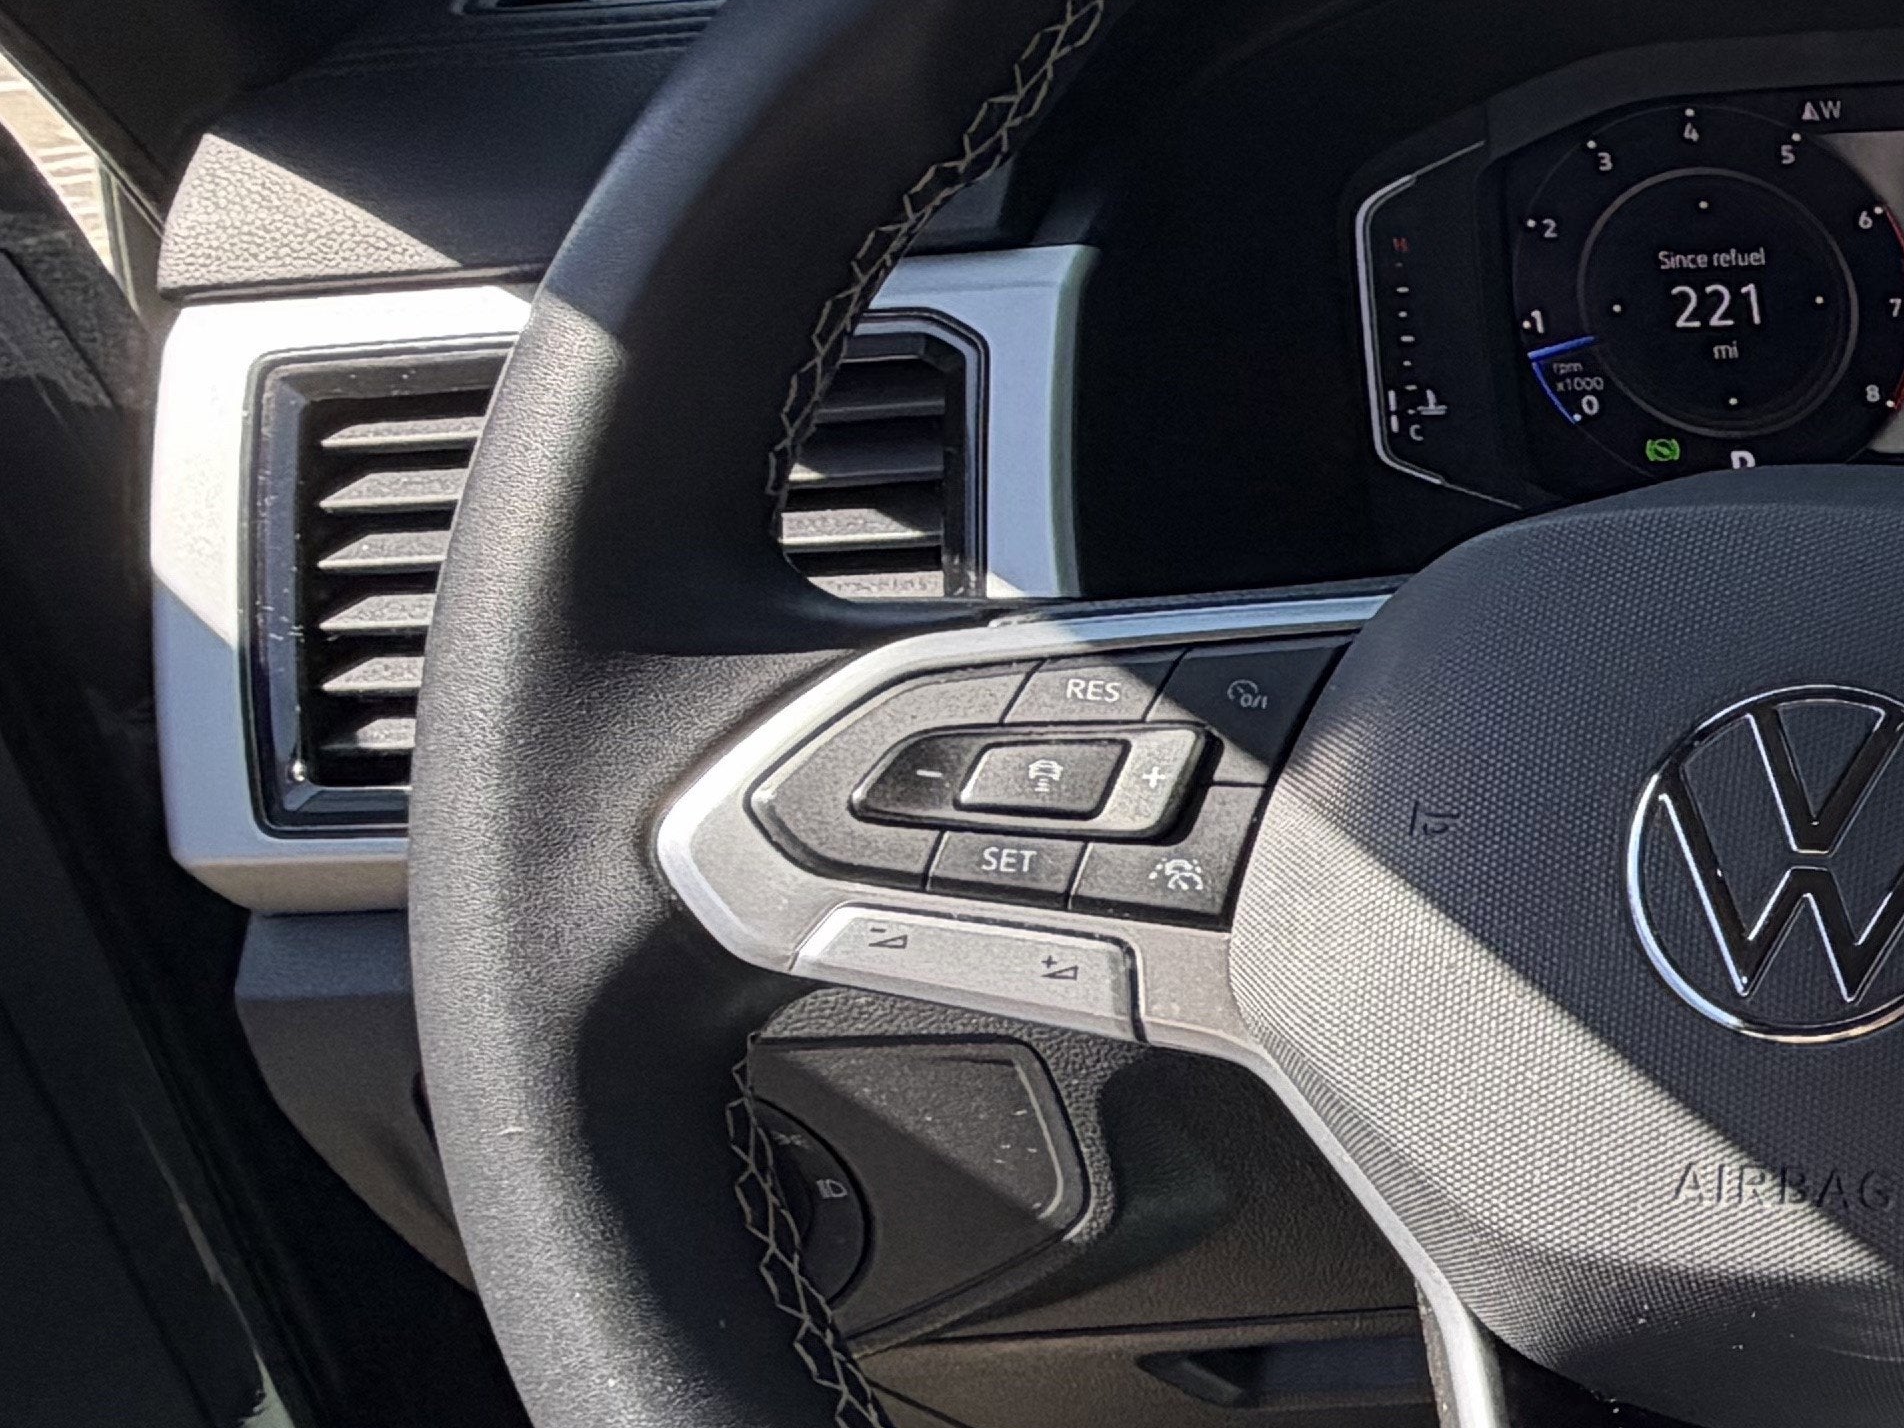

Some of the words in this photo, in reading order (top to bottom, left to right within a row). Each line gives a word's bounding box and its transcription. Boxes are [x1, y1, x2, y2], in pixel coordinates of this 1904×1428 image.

[1683, 122, 1700, 143] 4
[1597, 150, 1613, 172] 3
[1781, 143, 1795, 164] 5
[1543, 219, 1558, 239] 2
[1858, 210, 1873, 230] 6
[1658, 249, 1709, 271] Since
[1713, 246, 1767, 269] refuel
[1671, 283, 1763, 329] 221
[1889, 299, 1901, 318] 7
[1530, 308, 1545, 334] 1
[1712, 339, 1740, 360] mi
[1865, 383, 1881, 403] 8
[1582, 394, 1600, 416] 0
[1409, 423, 1425, 443] C
[1065, 677, 1122, 705] RES
[981, 845, 1039, 876] SET
[1672, 1161, 1900, 1213] AIRBAG
